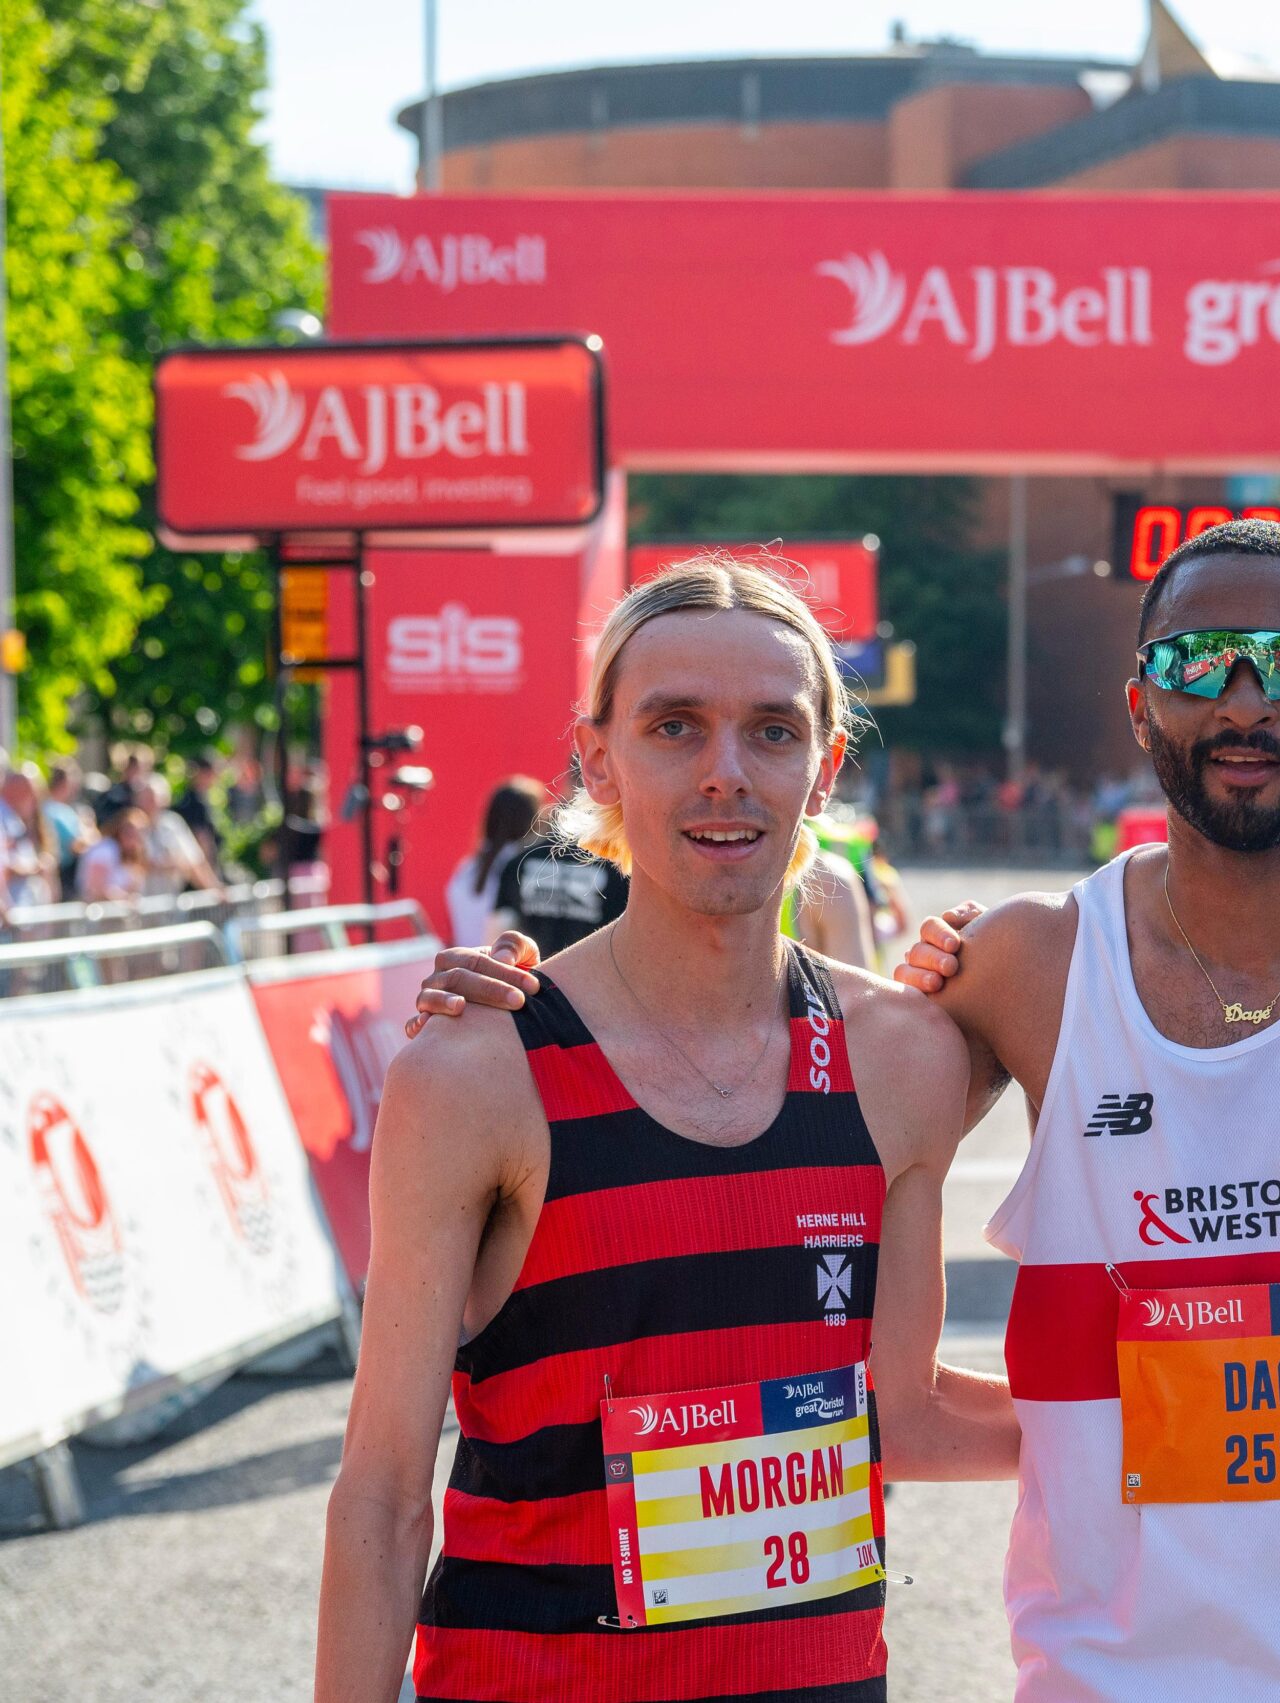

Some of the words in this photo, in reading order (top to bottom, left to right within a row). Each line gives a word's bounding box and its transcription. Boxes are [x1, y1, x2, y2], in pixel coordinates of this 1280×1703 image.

[402, 234, 546, 293] AJBell
[903, 266, 1152, 363] AJBell
[302, 381, 528, 475] AJBell
[796, 1213, 839, 1228] HERNE
[841, 1212, 867, 1227] HILL
[803, 1234, 864, 1249] HARRIERS
[823, 1313, 846, 1327] 1889
[1165, 1299, 1244, 1331] AJBell
[795, 1381, 824, 1399] AJBell
[857, 1370, 865, 1405] 2025
[658, 1399, 738, 1436] AJBell
[795, 1401, 817, 1418] great
[824, 1395, 844, 1410] bristol
[699, 1444, 844, 1518] MORGAN
[619, 1528, 633, 1565] T-SHIRT
[764, 1531, 810, 1589] 28
[856, 1543, 876, 1568] 10K
[623, 1567, 633, 1584] NO
